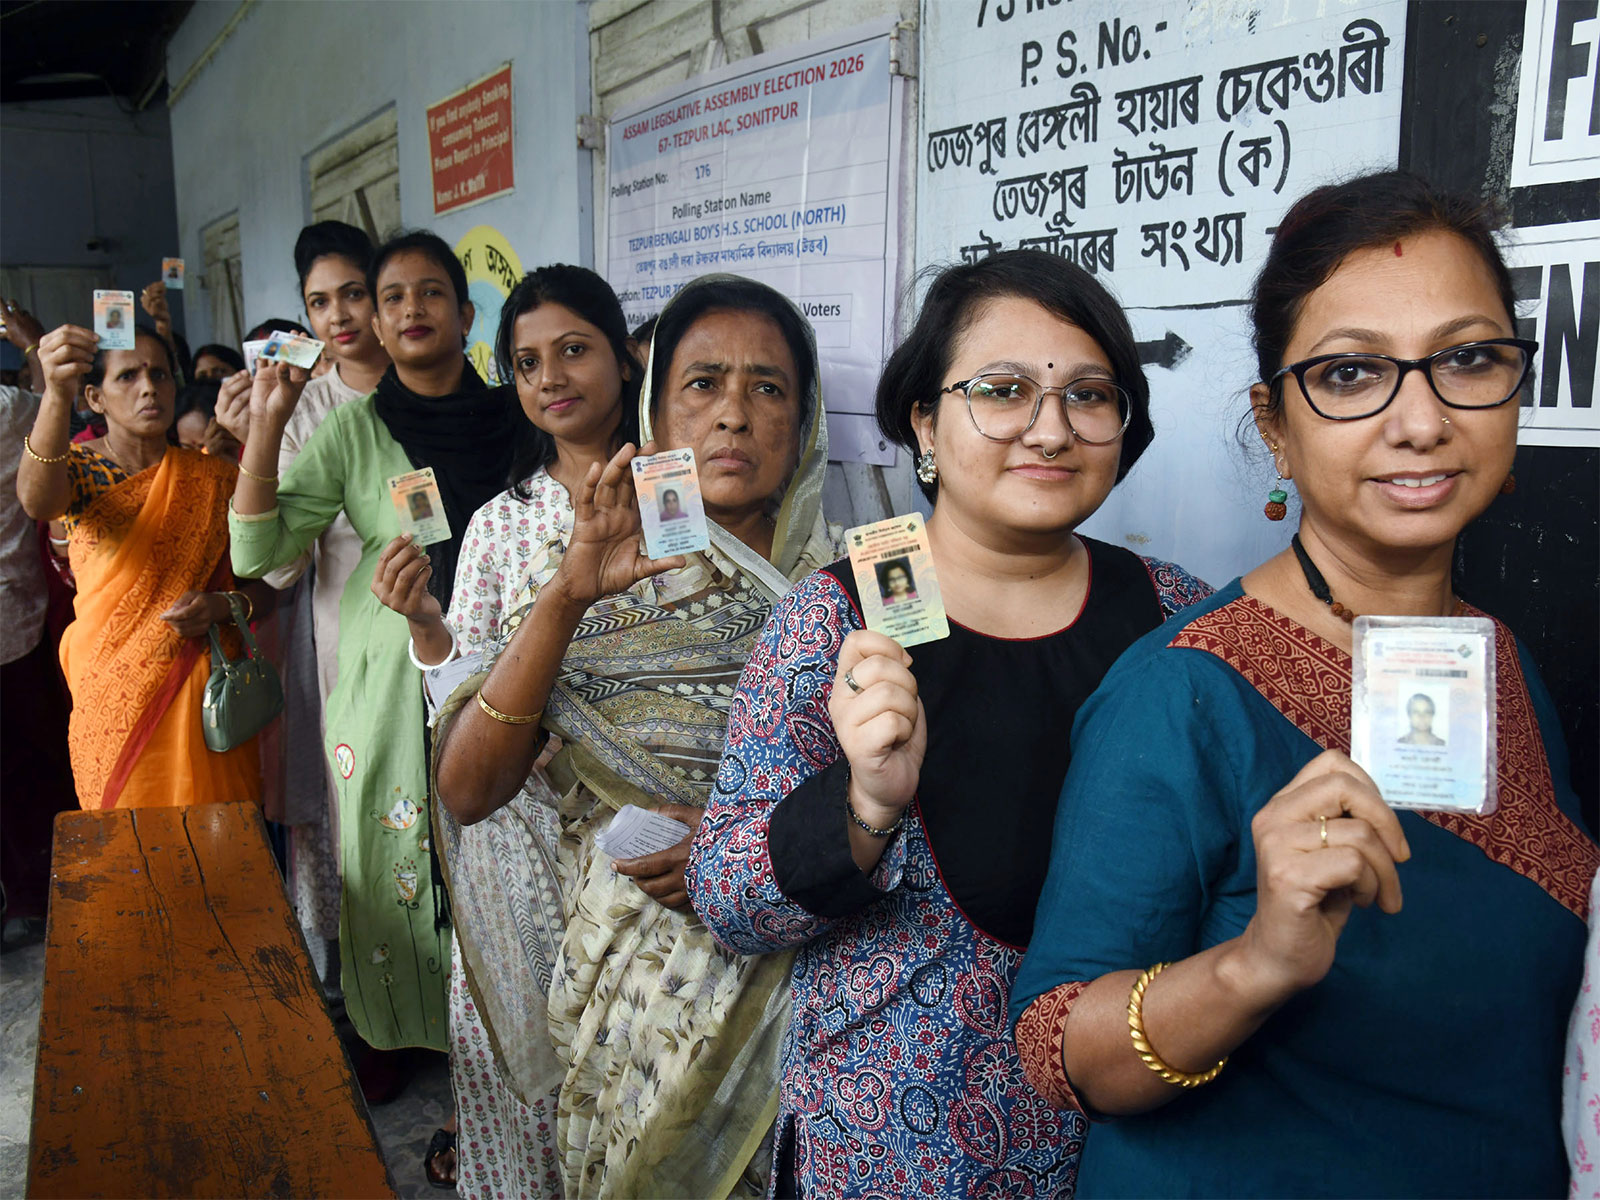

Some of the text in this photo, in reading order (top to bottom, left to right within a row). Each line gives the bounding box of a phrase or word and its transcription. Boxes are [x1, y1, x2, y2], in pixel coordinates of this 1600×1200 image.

[1021, 41, 1042, 87] P.
[1057, 31, 1087, 78] S.
[1544, 0, 1600, 141] F
[623, 54, 864, 140] ASSAM LEGISLATIVE ASSEMBLY ELECTION 2026
[674, 126, 709, 148] TEZPUR
[711, 117, 734, 138] LAC,
[737, 101, 798, 131] SONITPUR
[927, 116, 1006, 175] তেজপুৰ
[611, 174, 669, 198] Polling Station No:
[695, 166, 711, 180] 176
[993, 119, 1291, 227] তেজপুৰ টাউন (ক)
[672, 190, 771, 220] Polling Station Name
[694, 223, 720, 241] BOY'S
[722, 219, 741, 235] H.S.
[744, 212, 788, 233] SCHOOL
[792, 204, 846, 230] (NORTH)
[642, 284, 671, 299] TEZPUR
[803, 302, 841, 317] Voters
